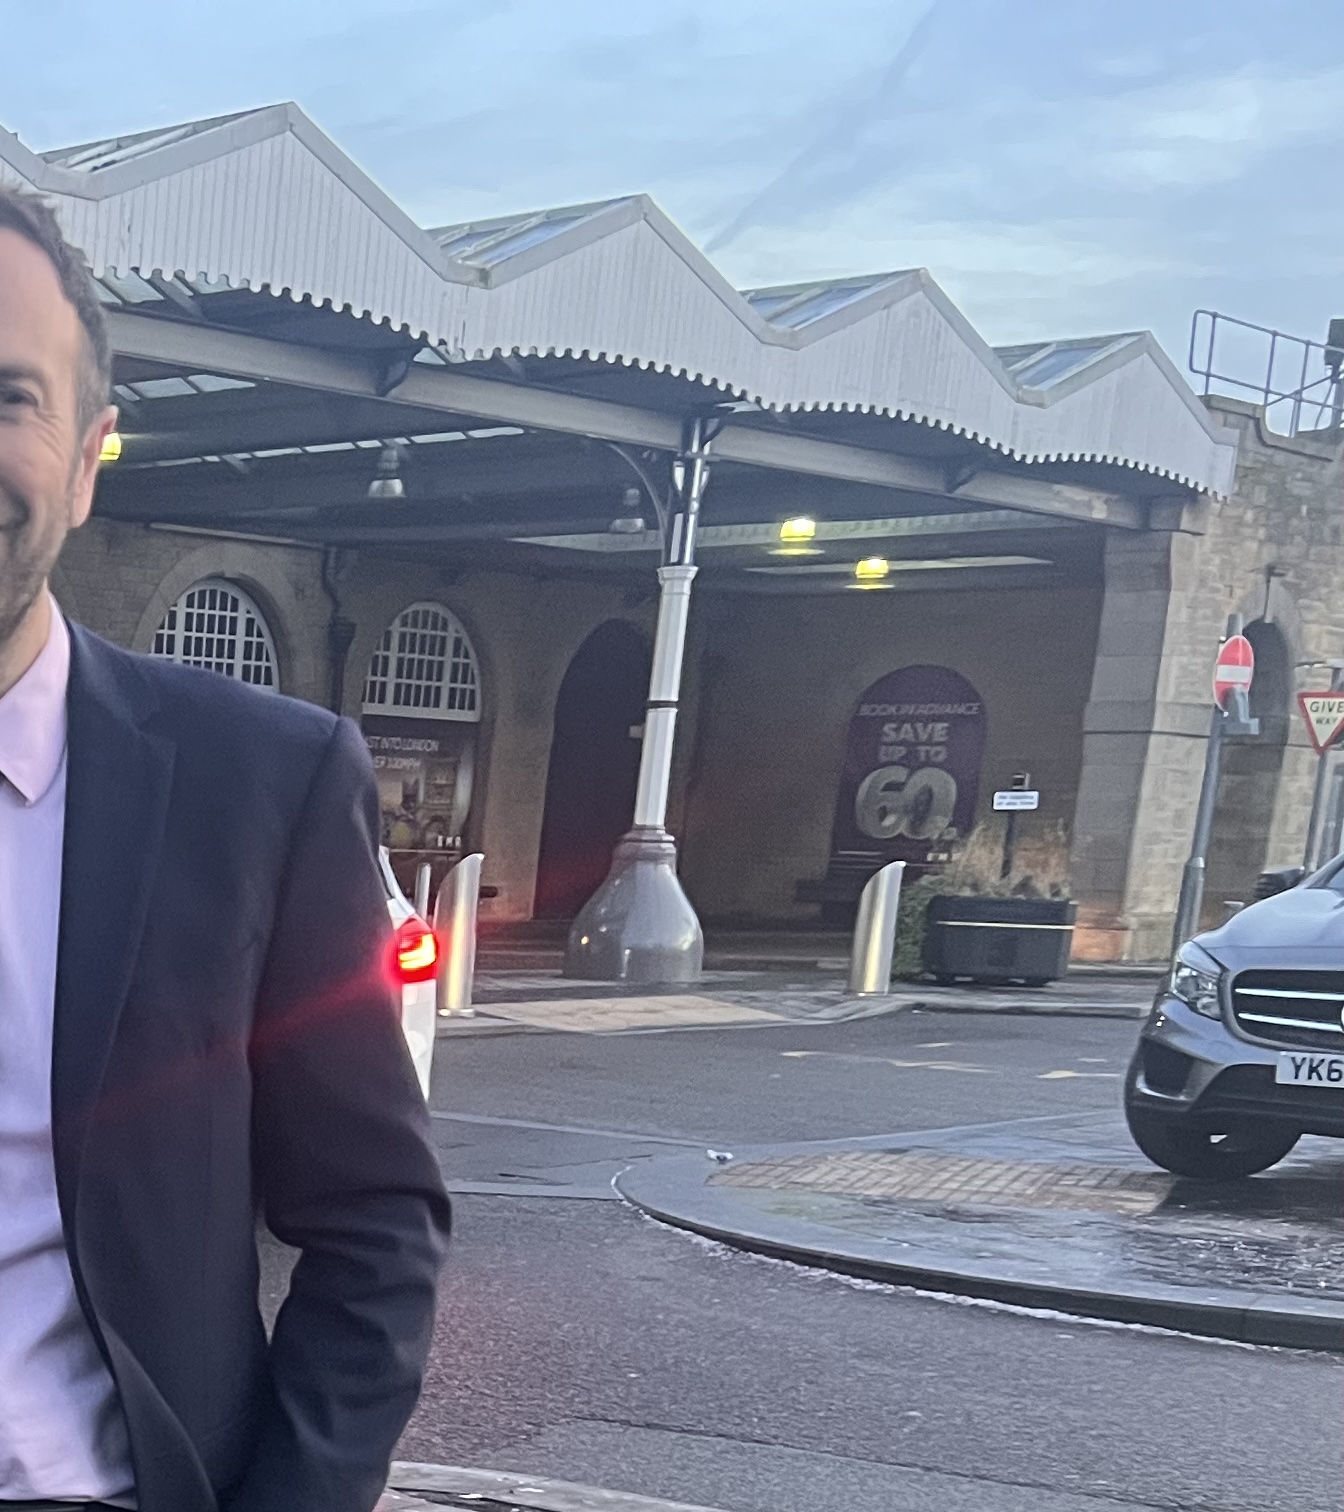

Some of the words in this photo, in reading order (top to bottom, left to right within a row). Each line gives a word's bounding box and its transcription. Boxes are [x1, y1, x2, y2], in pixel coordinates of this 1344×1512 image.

[1310, 701, 1344, 713] GIVE
[1315, 717, 1338, 725] WAY
[882, 722, 950, 742] SAVE
[402, 738, 439, 752] LONDON
[878, 745, 907, 762] UP
[916, 745, 948, 762] TO
[1291, 1056, 1344, 1082] YK6
